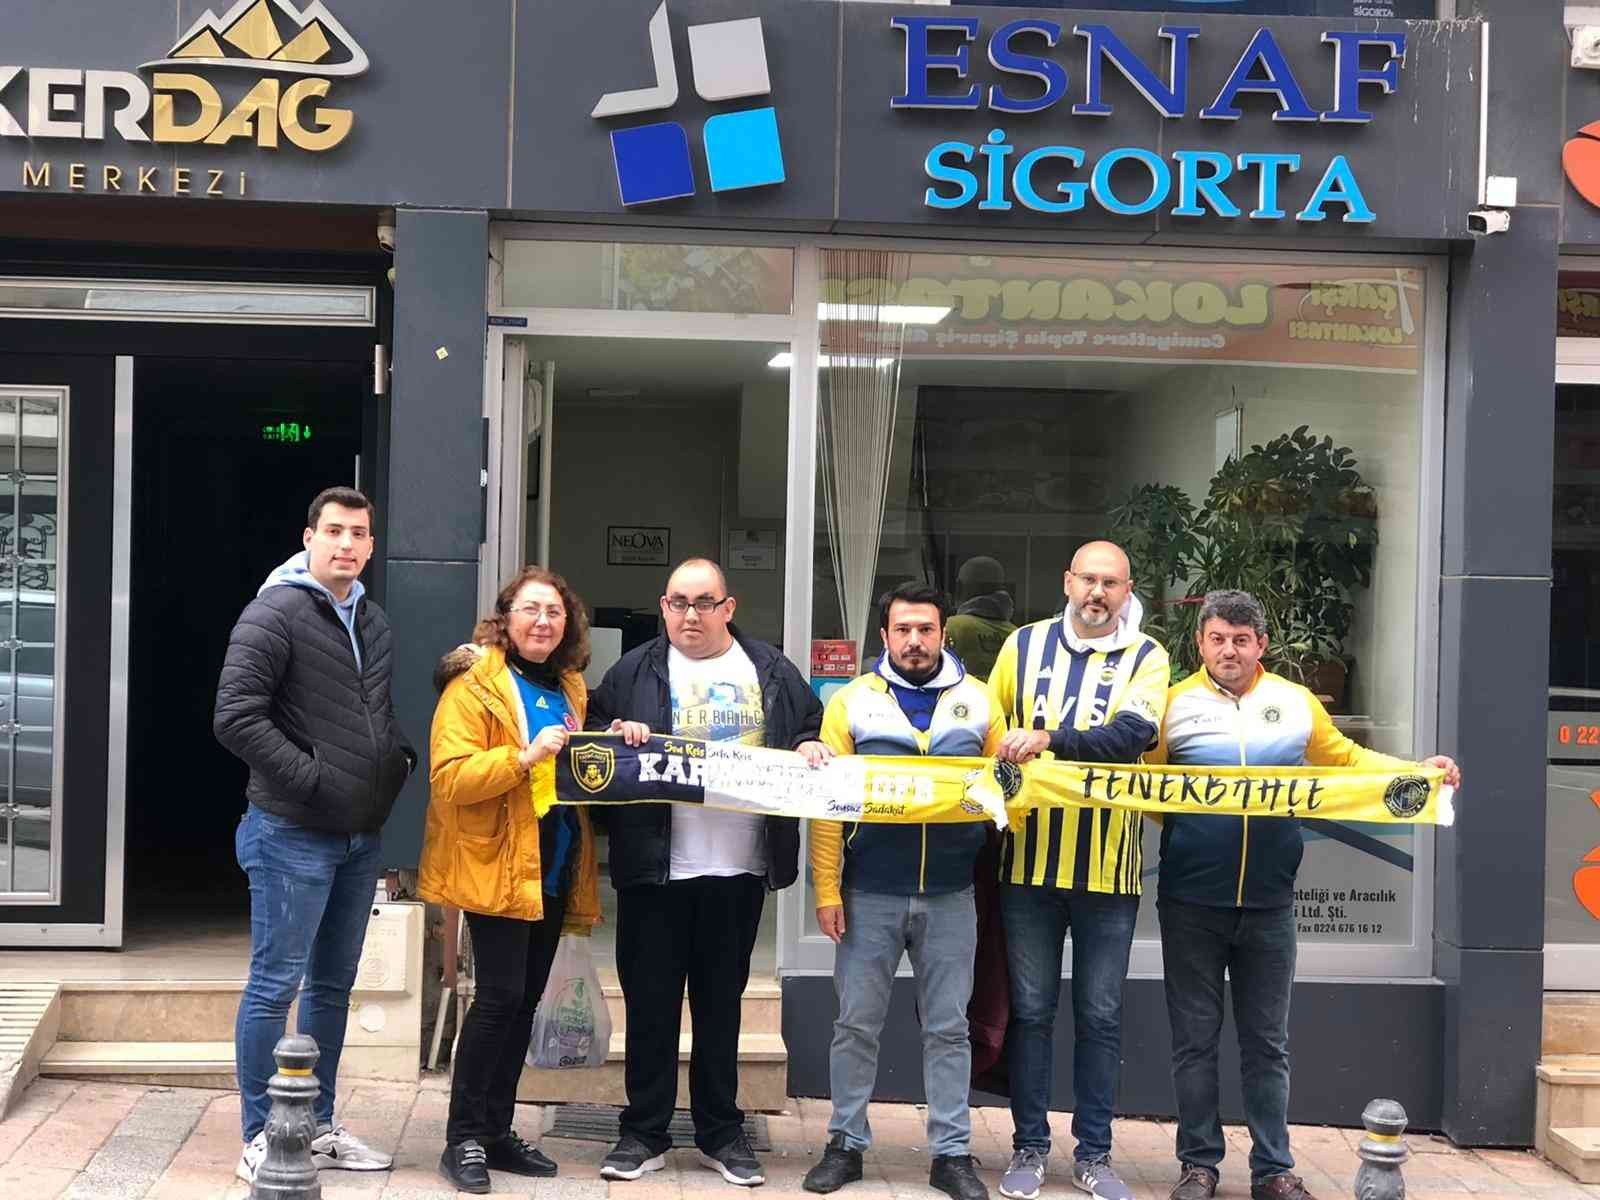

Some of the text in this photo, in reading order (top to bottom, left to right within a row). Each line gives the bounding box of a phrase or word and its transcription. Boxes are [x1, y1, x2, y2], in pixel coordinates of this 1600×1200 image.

[890, 16, 1406, 123] ESNAF
[924, 129, 1376, 223] SİGORTA
[611, 532, 665, 549] NEOVA
[1082, 766, 1325, 818] FENERBAHÇE
[1333, 891, 1346, 901] ve
[1302, 905, 1324, 918] Ltd.
[1327, 905, 1347, 922] Şti.
